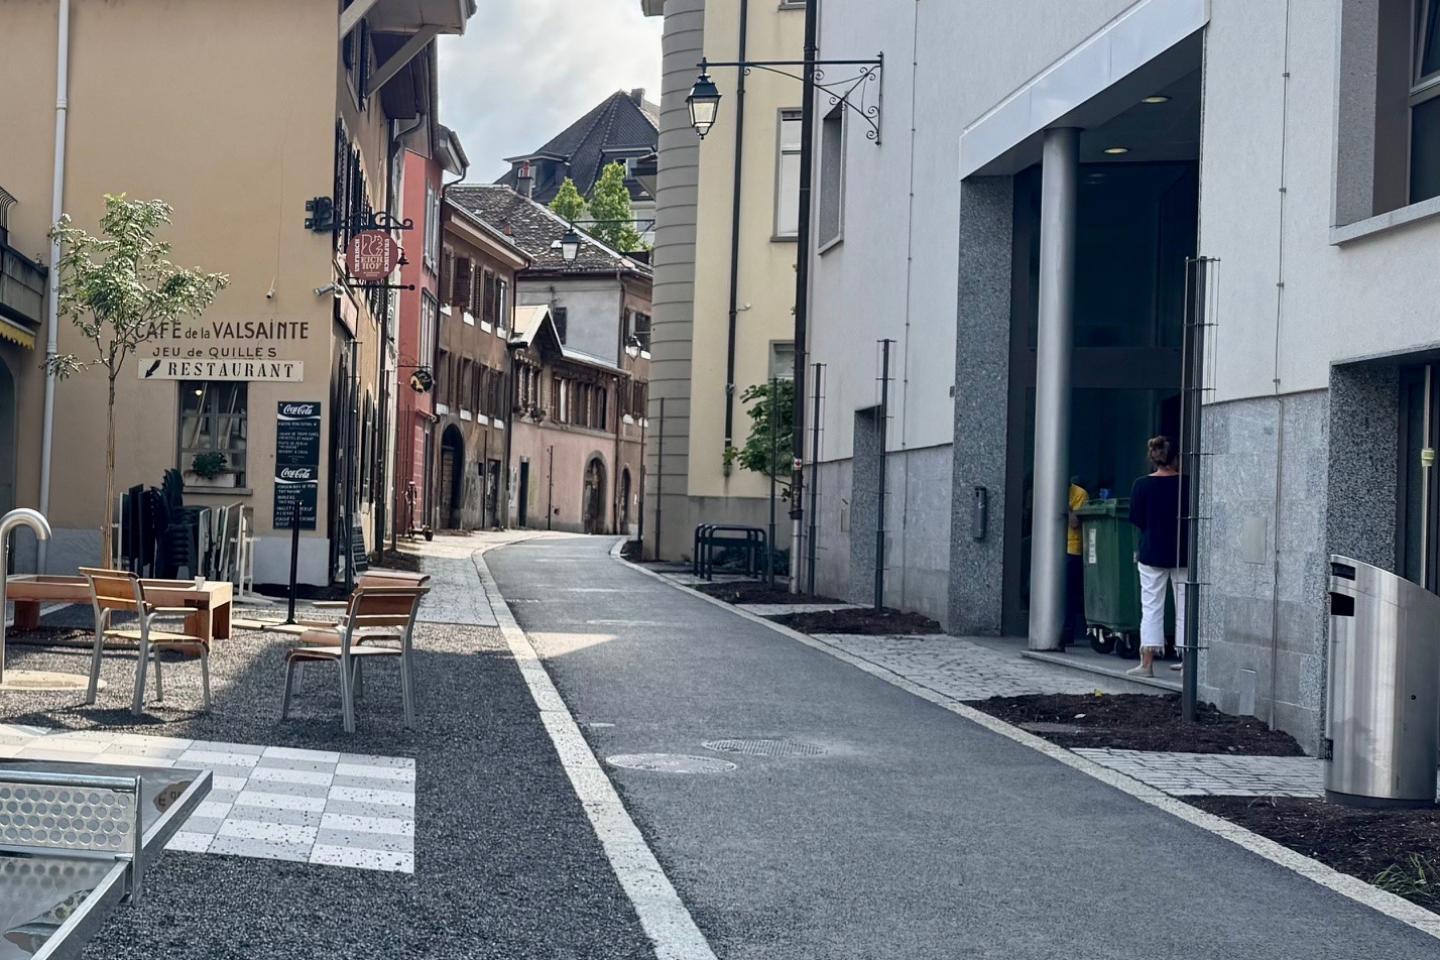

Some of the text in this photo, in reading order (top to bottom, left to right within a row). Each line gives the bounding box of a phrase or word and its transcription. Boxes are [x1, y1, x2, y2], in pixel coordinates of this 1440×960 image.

[185, 328, 198, 339] de
[201, 327, 210, 339] la
[153, 347, 277, 358] JEU de QUILLES
[168, 362, 294, 378] RESTAURANT
